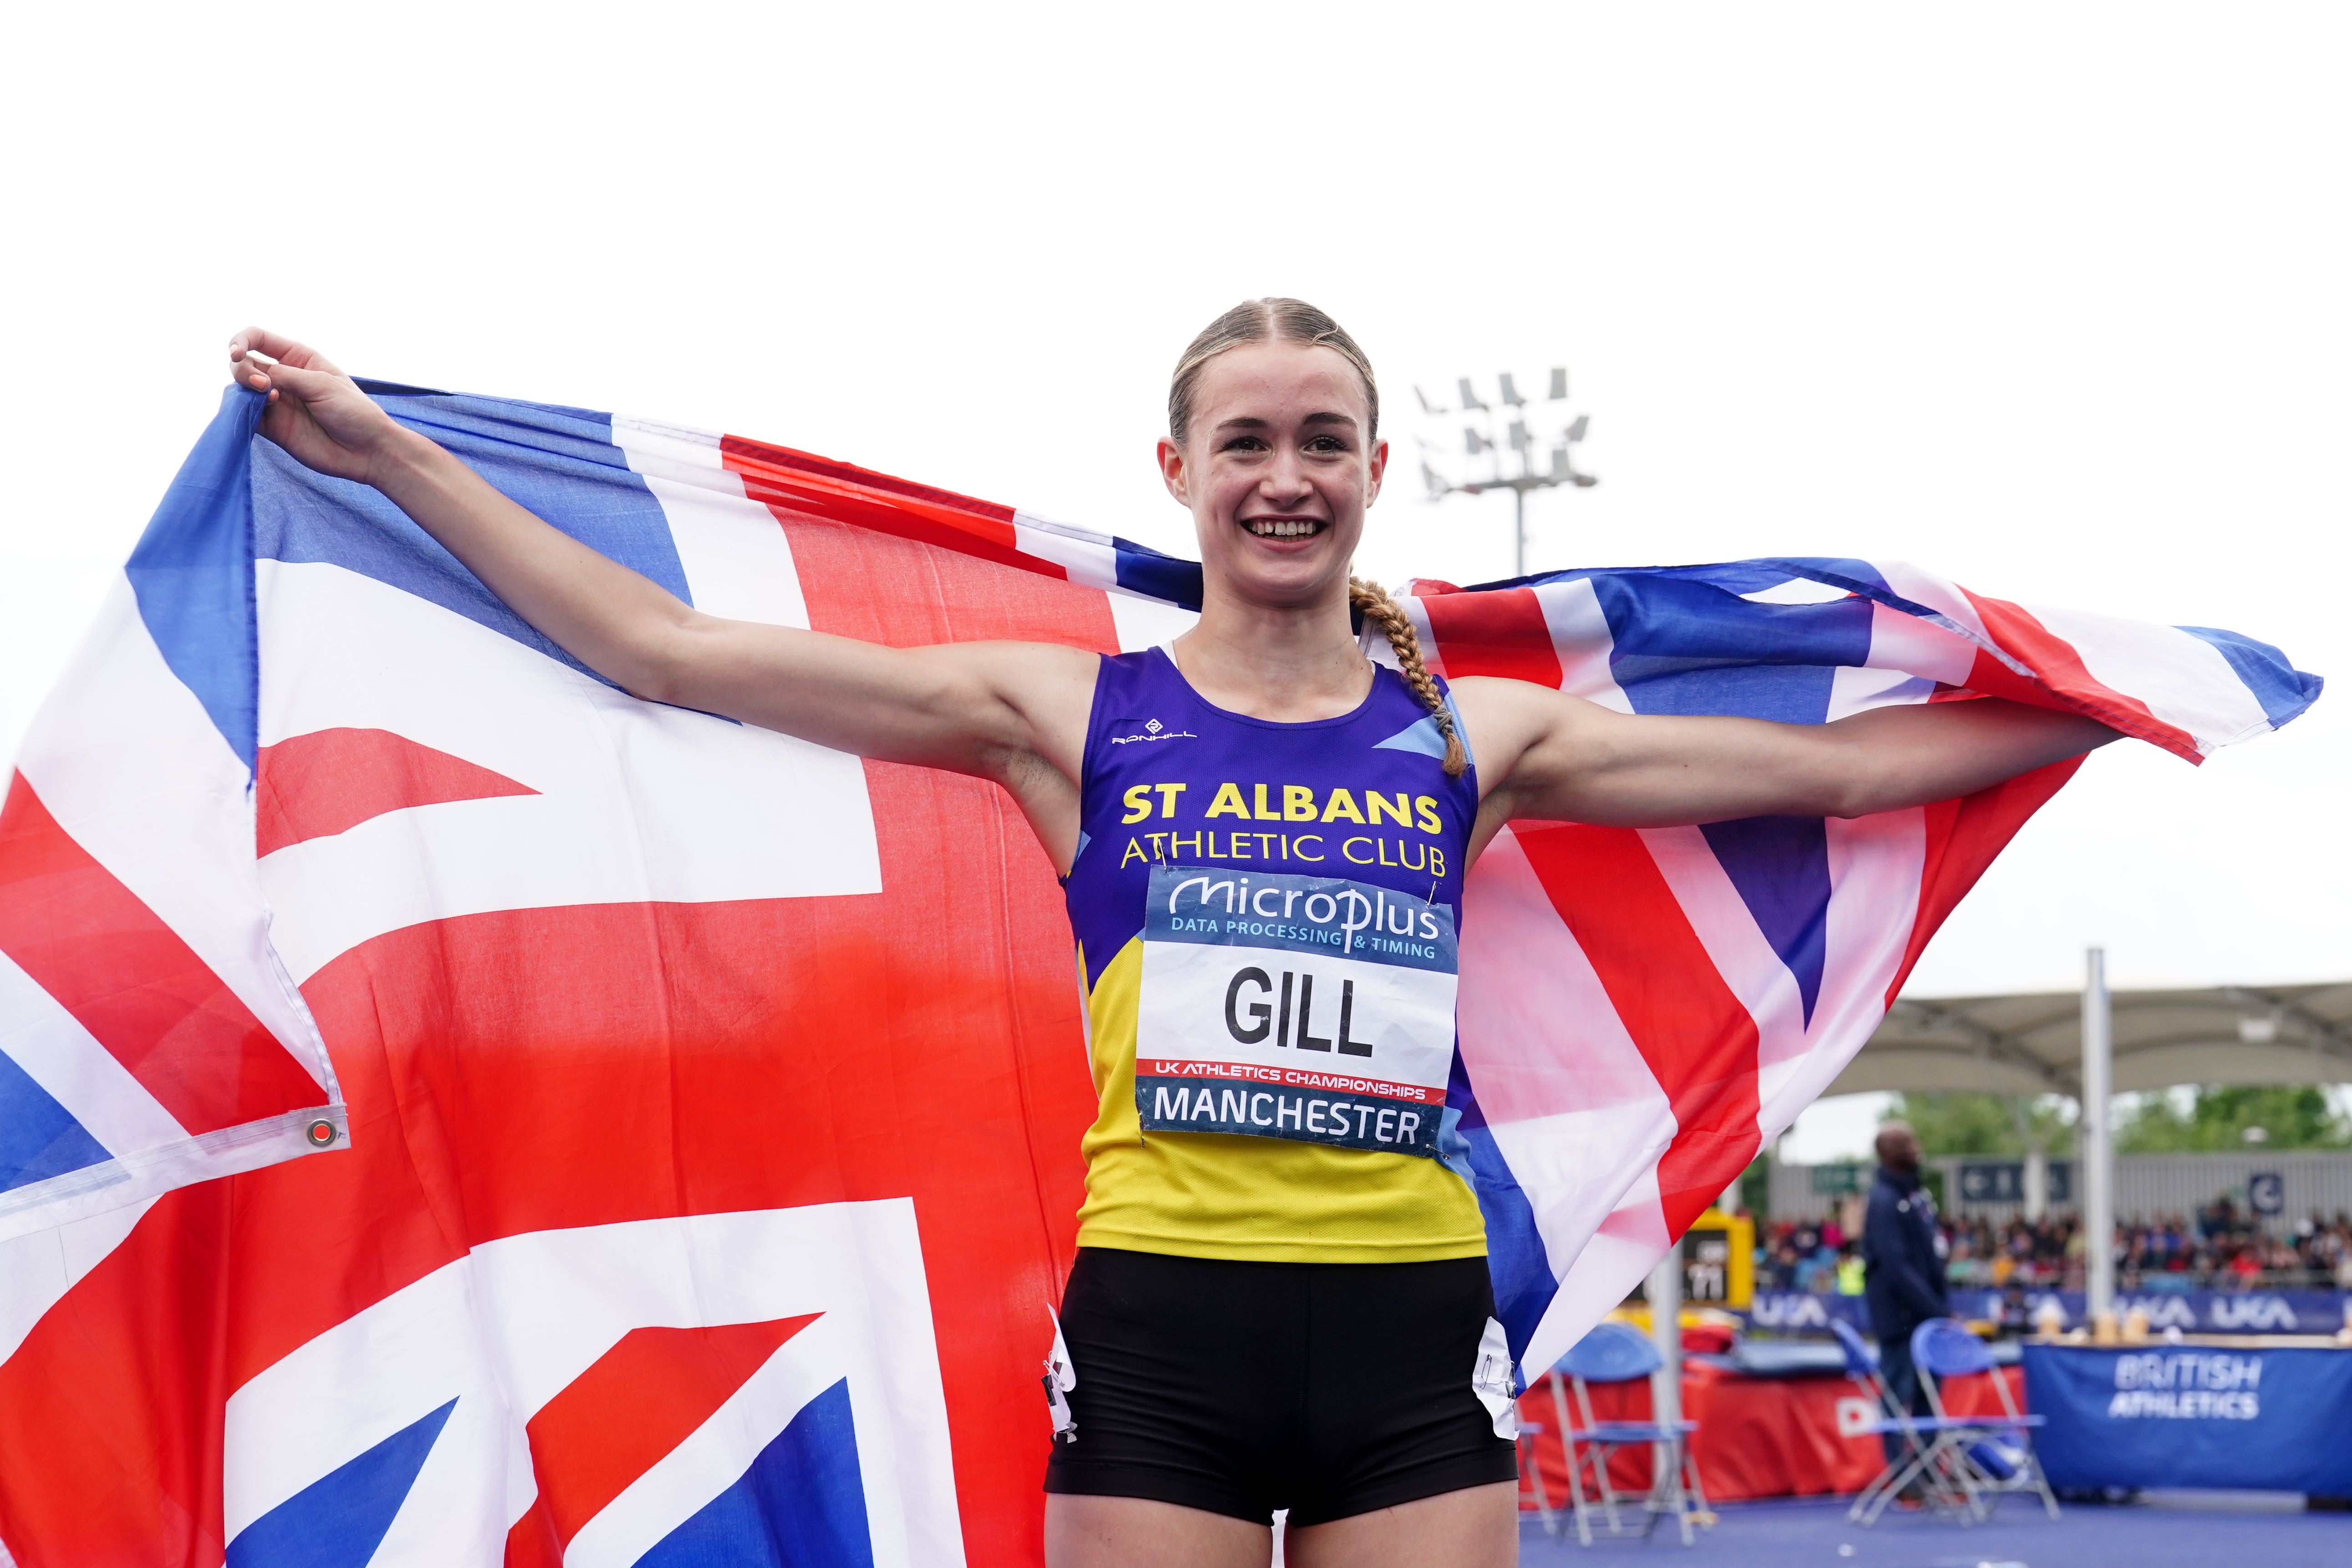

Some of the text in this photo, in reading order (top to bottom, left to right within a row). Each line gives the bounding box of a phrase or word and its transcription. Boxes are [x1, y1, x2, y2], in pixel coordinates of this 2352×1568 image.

[1112, 731, 1197, 744] RONHILL
[1121, 782, 1442, 835] ST ALBANS
[1120, 830, 1445, 878] ATHLETIC CLUB
[1171, 917, 1435, 959] DATA PROCESSING & TIMING
[1225, 966, 1373, 1058] GILL
[1155, 1061, 1426, 1101] UK ATHLETICS CHAMPIONSHIPS
[1154, 1086, 1420, 1145] MANCHESTER
[2114, 1353, 2262, 1390] BRITISH
[2107, 1390, 2260, 1420] ATHLETICS
